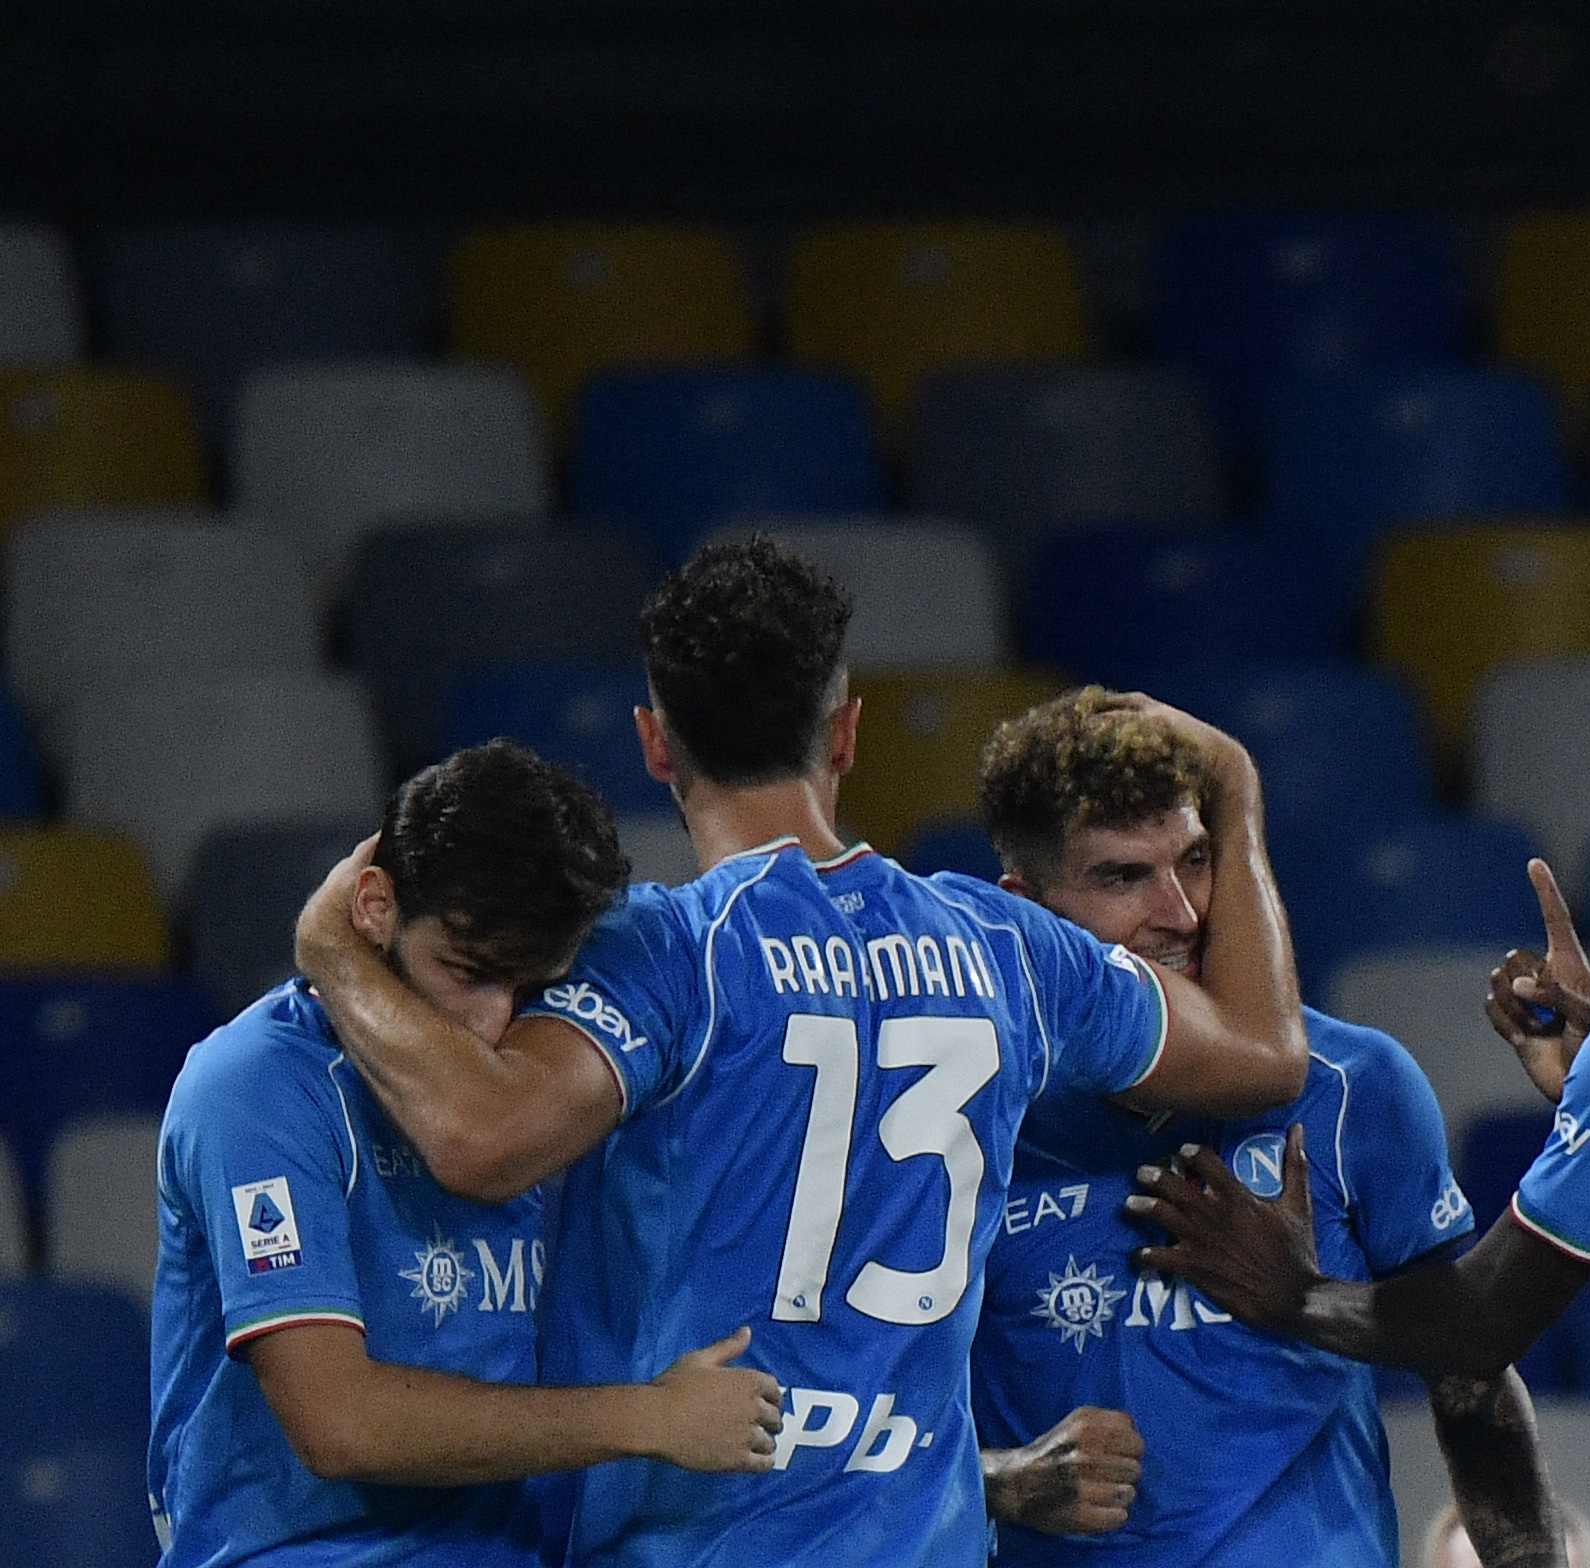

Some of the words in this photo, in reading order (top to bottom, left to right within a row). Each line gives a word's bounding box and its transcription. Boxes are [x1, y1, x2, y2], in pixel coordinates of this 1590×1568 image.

[760, 934, 995, 1001] RRAMANI
[543, 982, 648, 1052] ebay
[771, 1013, 999, 1326] 13
[1246, 1145, 1280, 1184] N
[1004, 1183, 1090, 1235] EA7
[251, 1237, 280, 1249] SERIE
[283, 1234, 291, 1243] A
[271, 1255, 296, 1268] TIM
